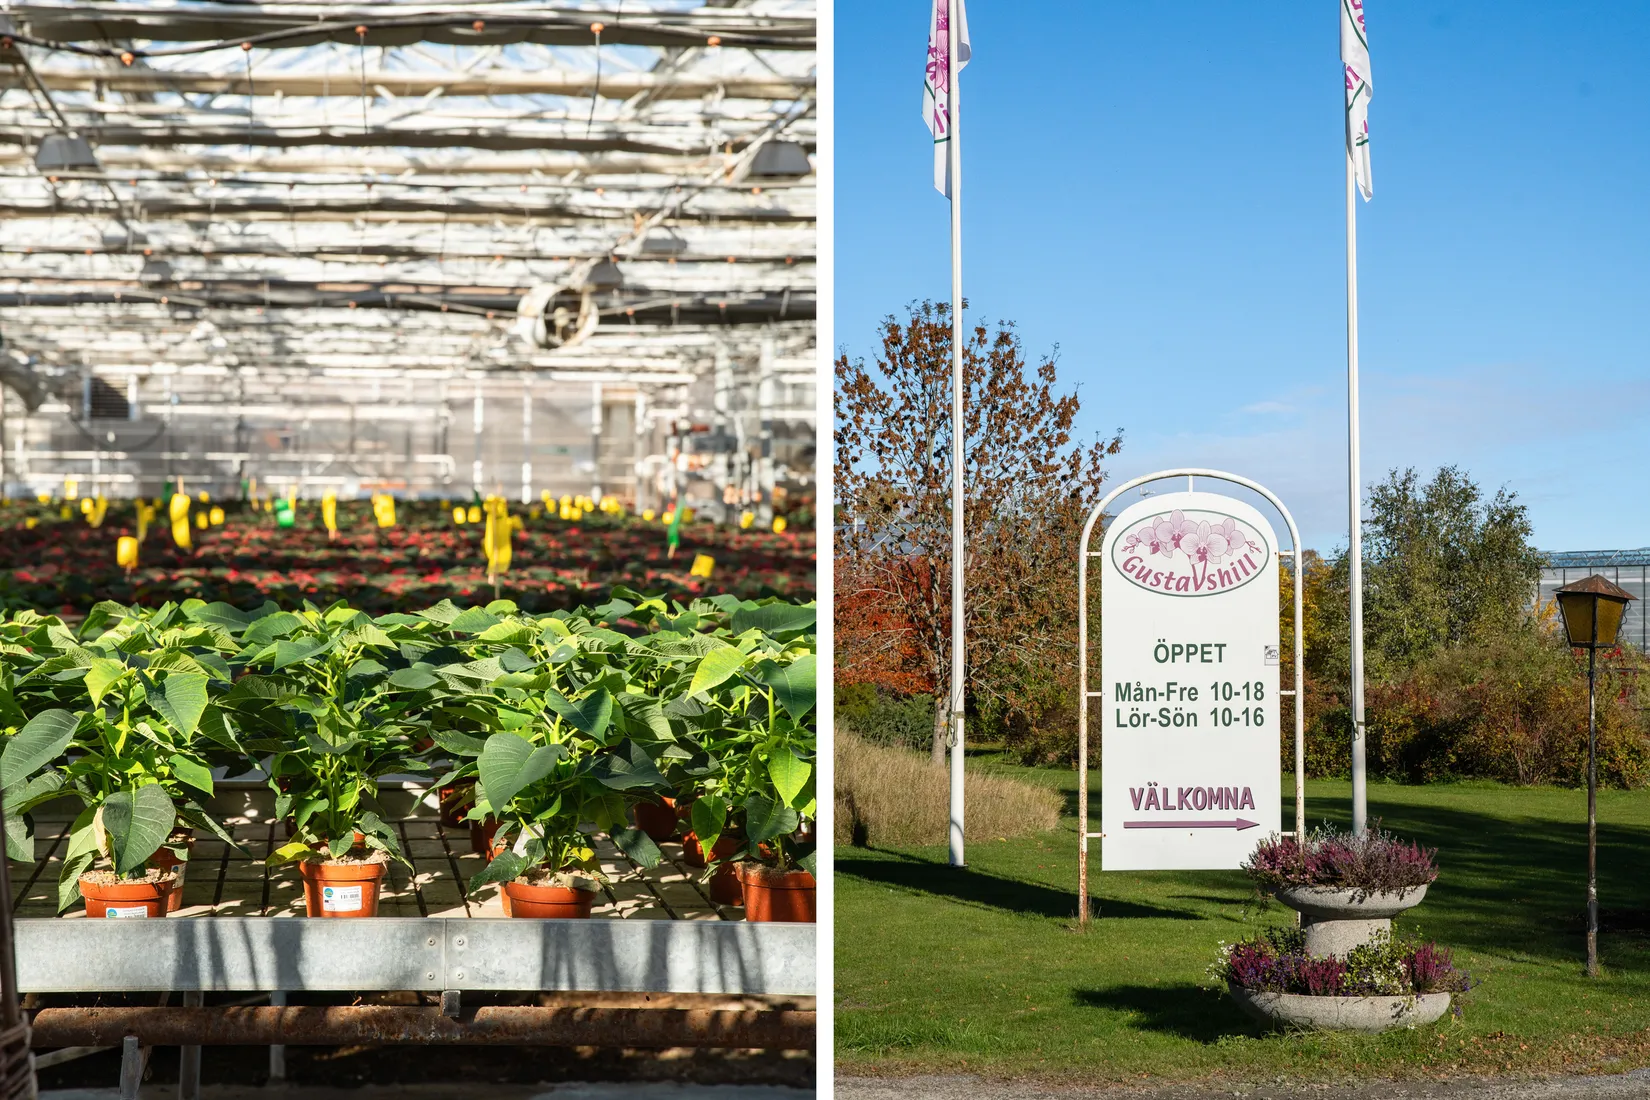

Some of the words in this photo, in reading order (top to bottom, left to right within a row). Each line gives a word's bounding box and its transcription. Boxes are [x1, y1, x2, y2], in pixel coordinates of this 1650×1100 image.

[1122, 553, 1257, 592] Gustavshill
[1153, 638, 1227, 663] ÖPPET
[1115, 681, 1199, 702] Mån-Fre
[1210, 681, 1265, 702] 10-18
[1115, 706, 1198, 728] Lör-Sön
[1210, 706, 1265, 727] 10-16
[1130, 781, 1255, 811] VÄLKOMNA
